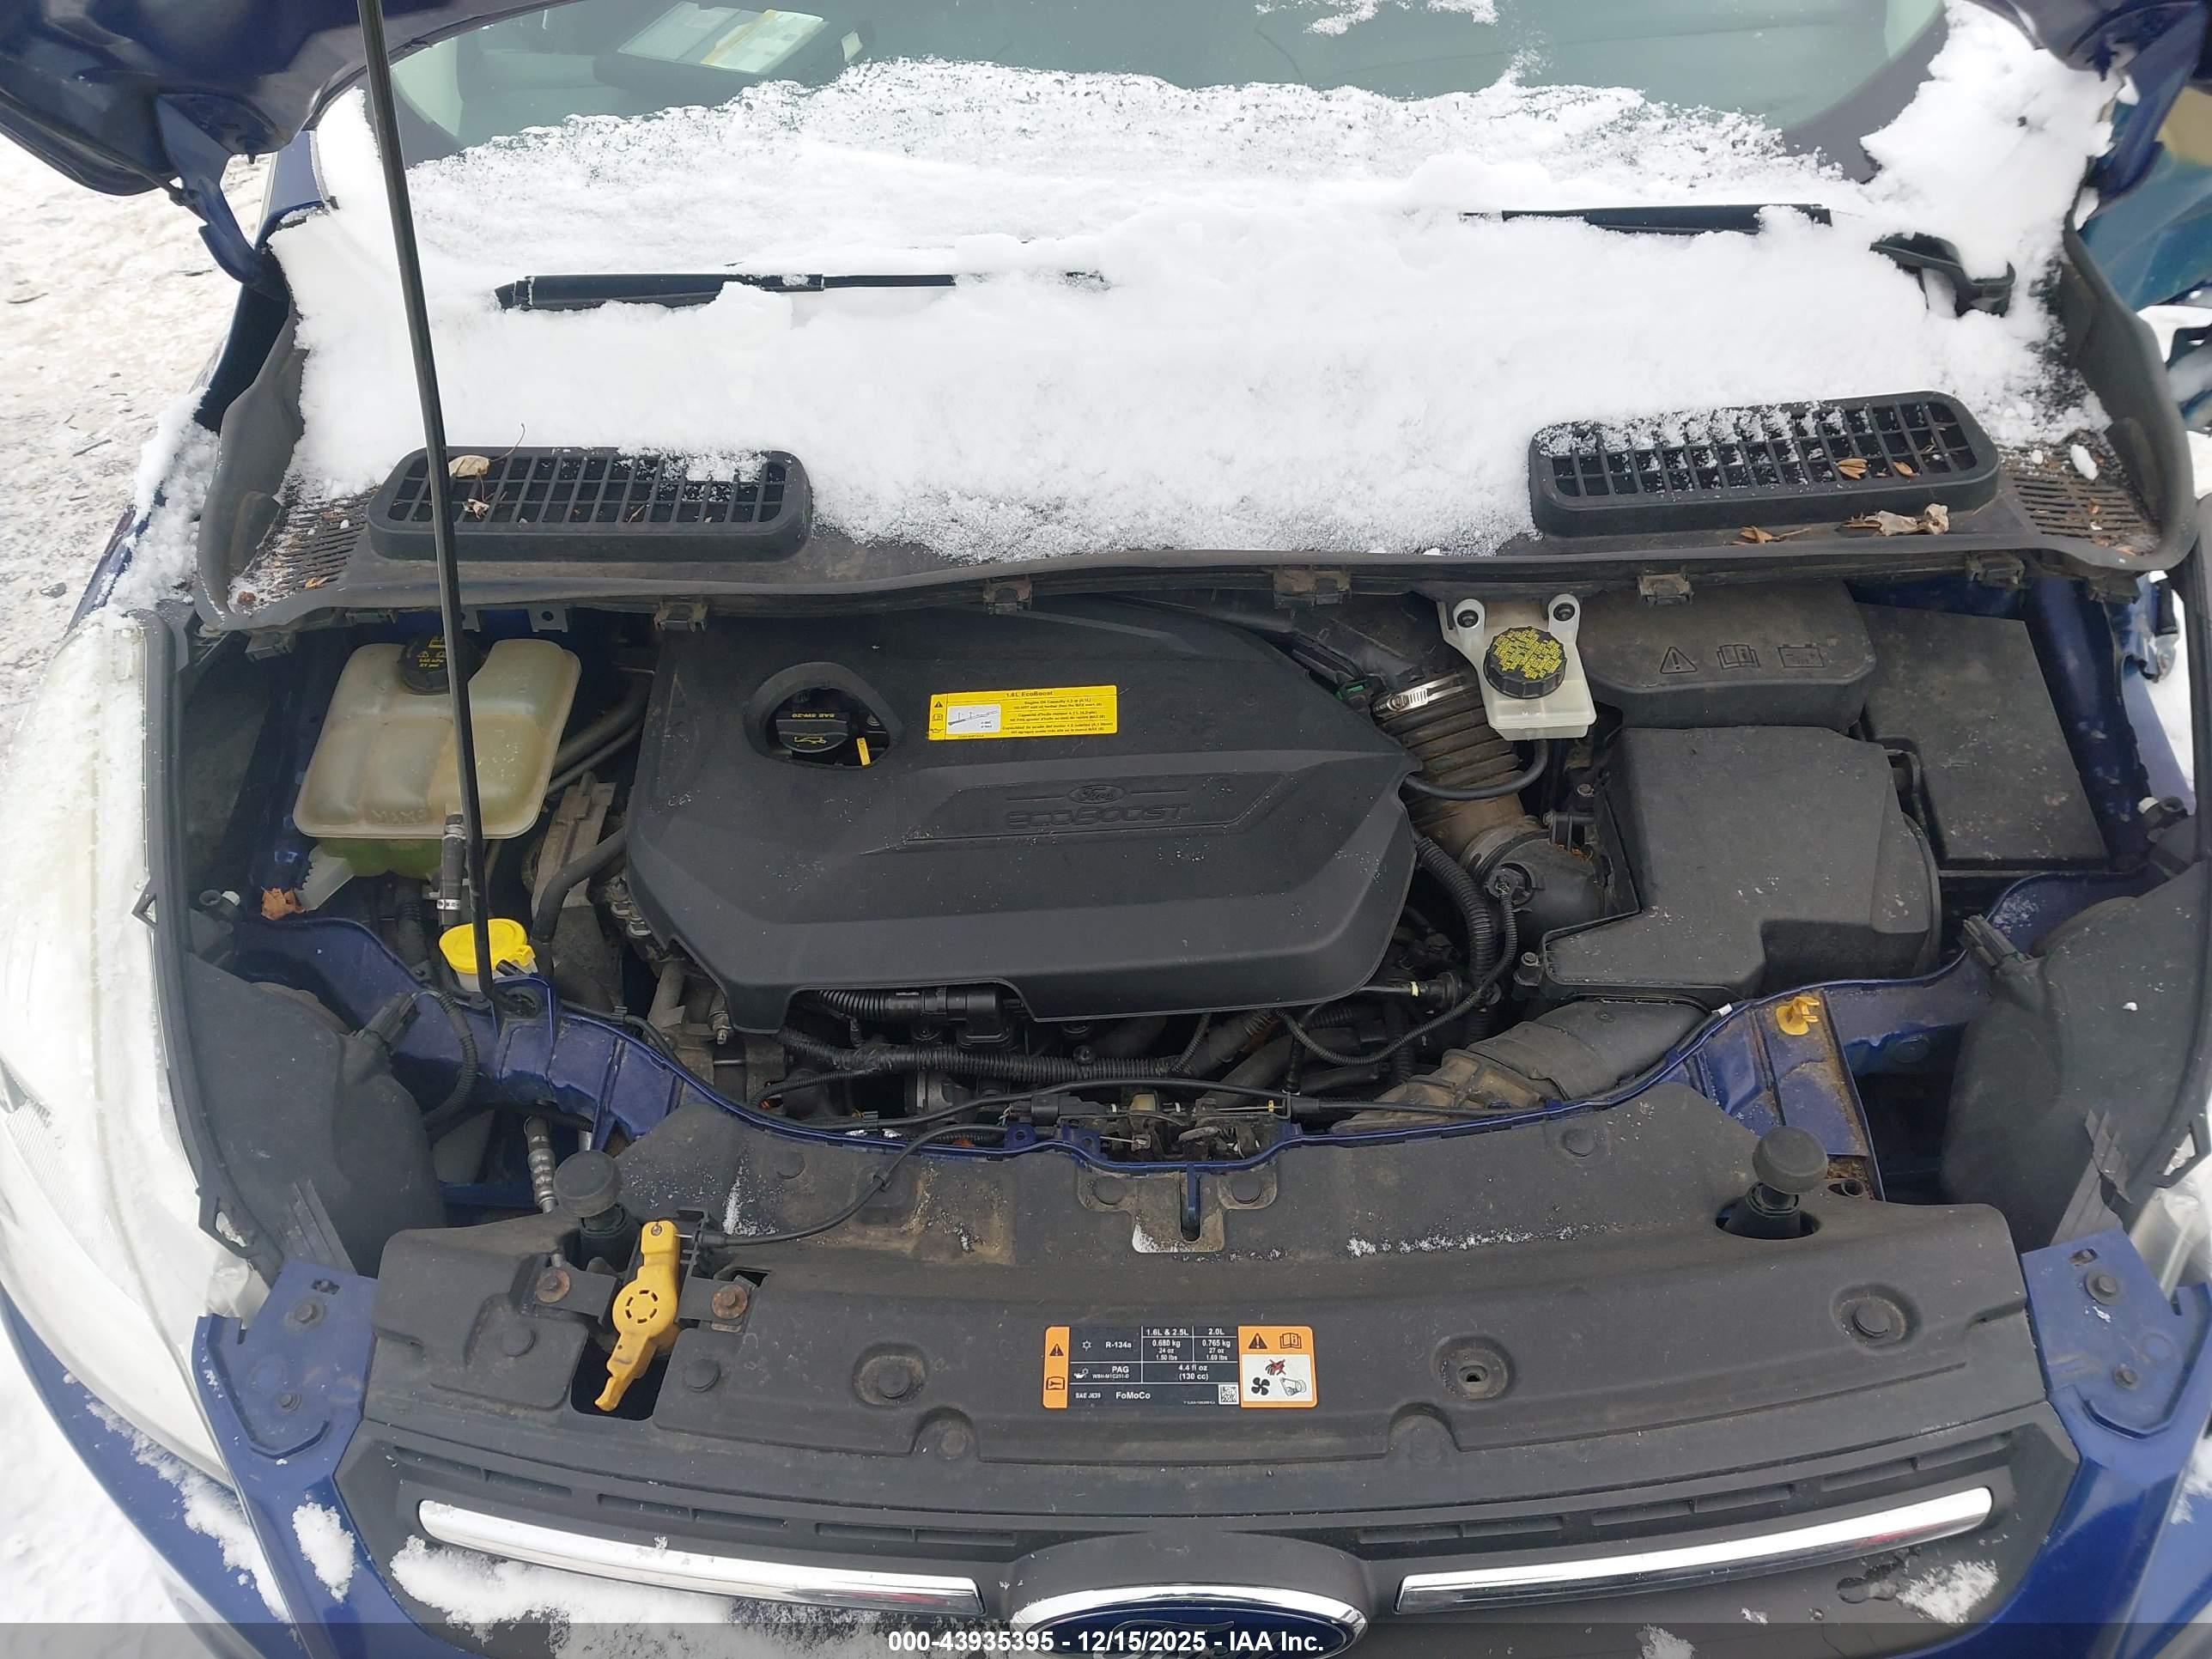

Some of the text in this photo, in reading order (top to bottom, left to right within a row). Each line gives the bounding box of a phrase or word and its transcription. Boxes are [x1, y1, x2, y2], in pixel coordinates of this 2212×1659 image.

[1105, 1340, 1132, 1349] R-134a
[1172, 1340, 1181, 1348] kg
[1222, 1340, 1231, 1348] kg
[1178, 1372, 1209, 1381] (130 cc)
[1115, 1391, 1151, 1400] FoMoCo
